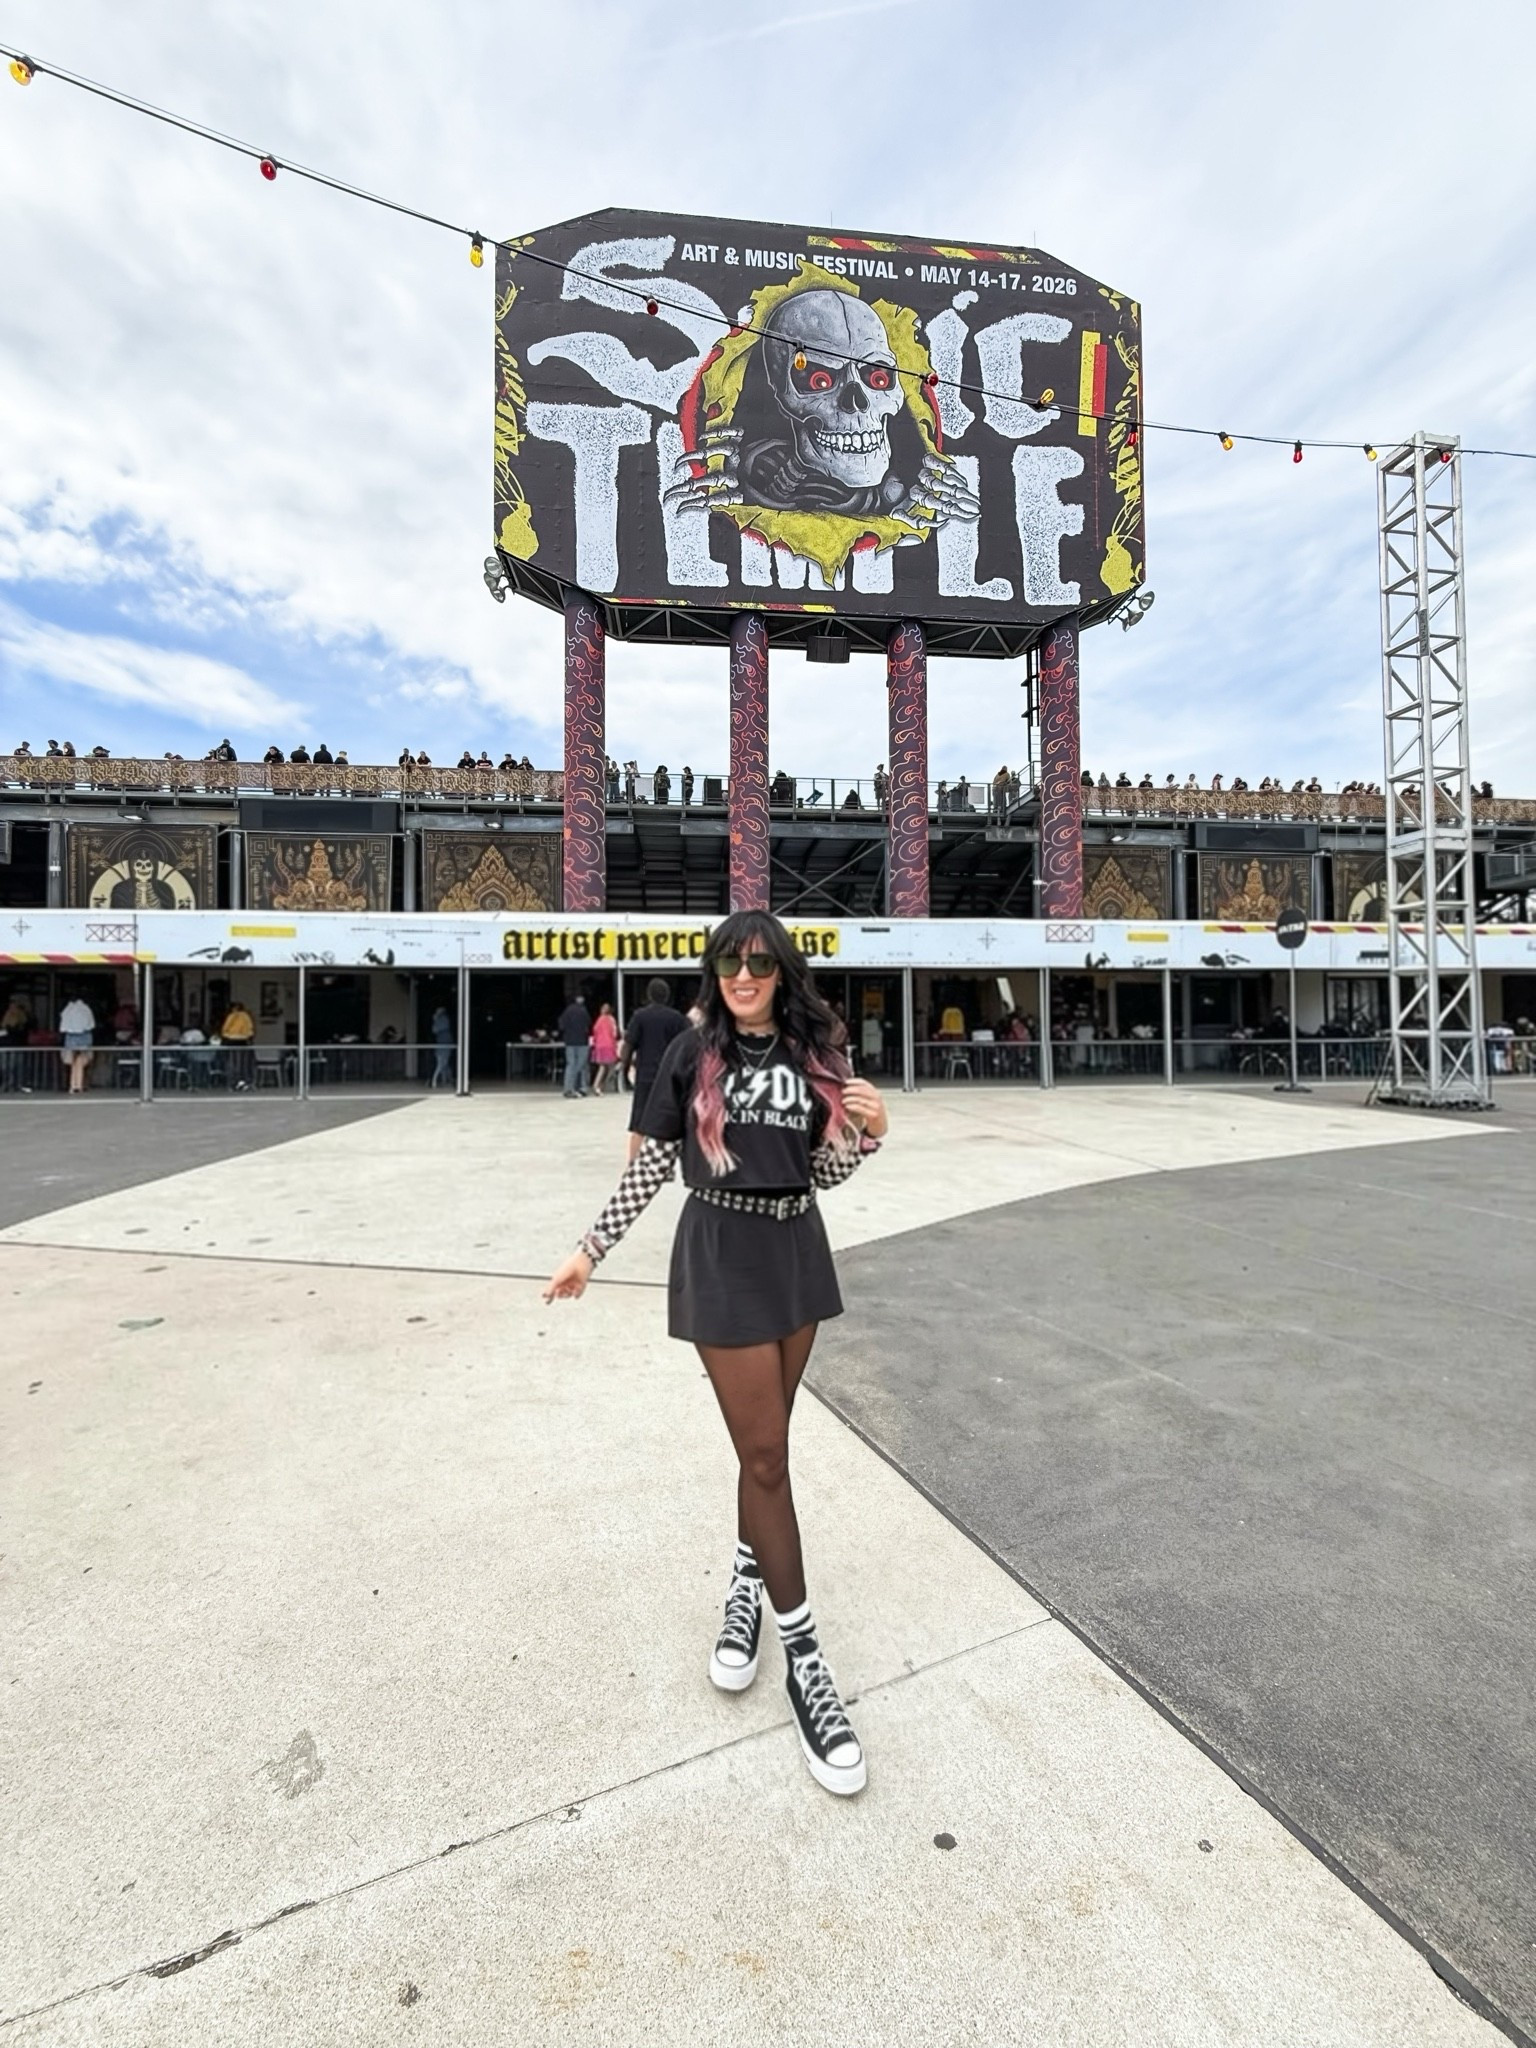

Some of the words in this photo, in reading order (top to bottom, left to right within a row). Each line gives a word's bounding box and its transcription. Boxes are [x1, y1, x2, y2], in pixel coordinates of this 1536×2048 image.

[681, 243, 719, 263] ART
[724, 246, 740, 266] &
[812, 254, 898, 280] FESTIVAL
[920, 264, 960, 284] MAY
[967, 269, 1026, 292] 14-17.
[1032, 275, 1077, 296] 2026
[502, 928, 606, 961] artist
[741, 1110, 760, 1124] IN
